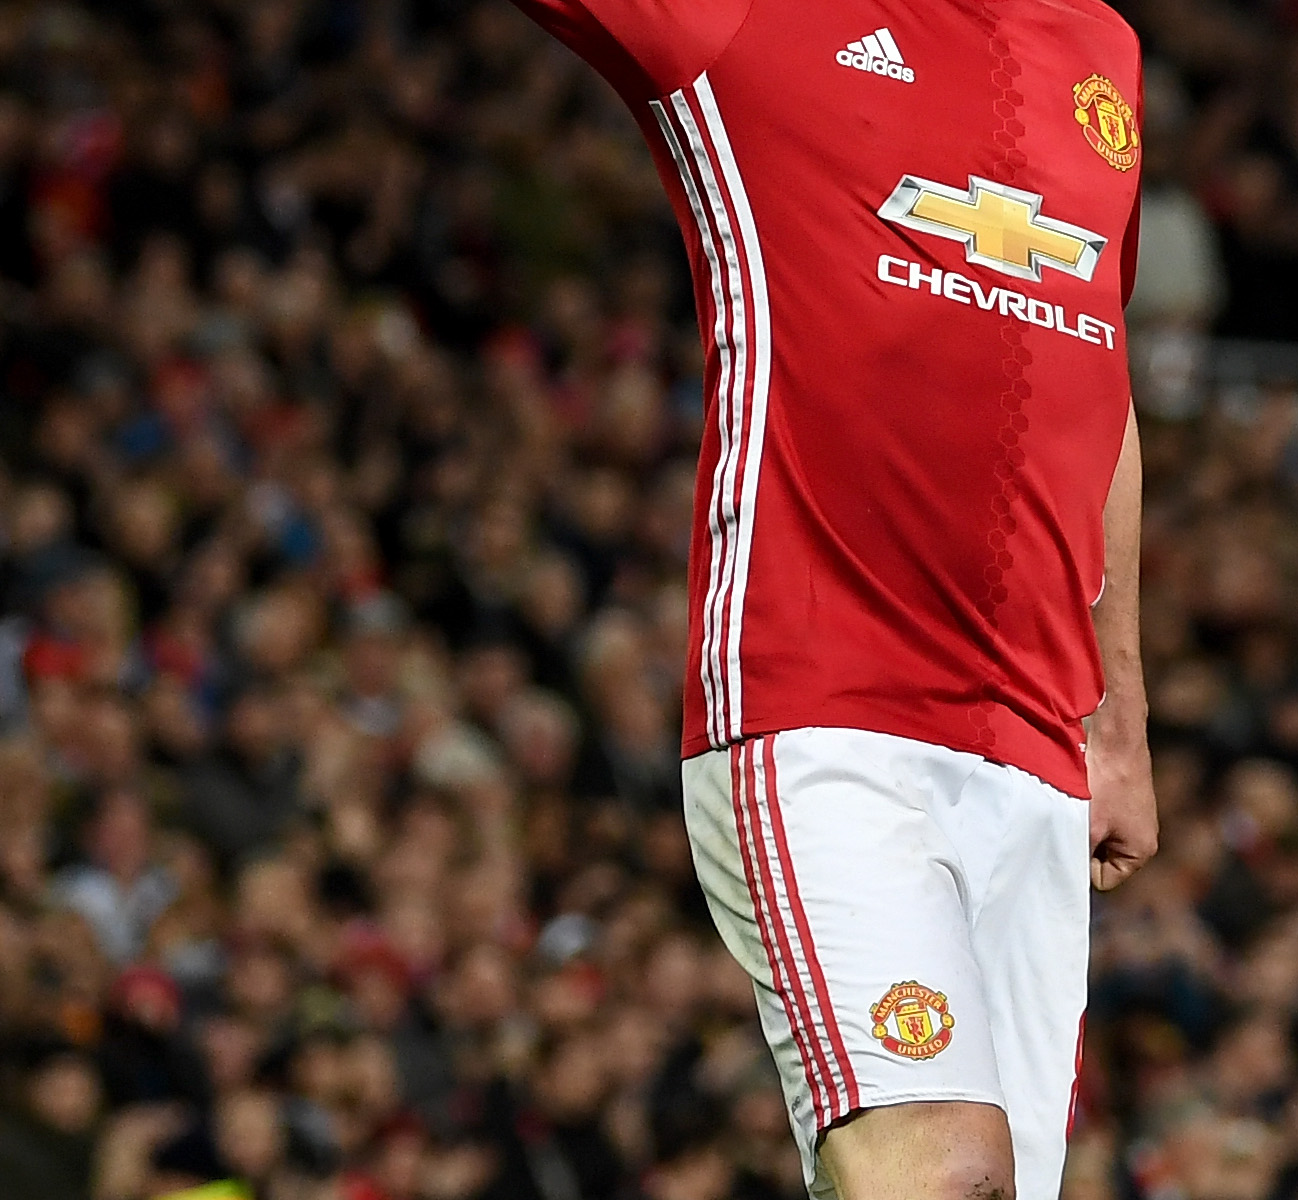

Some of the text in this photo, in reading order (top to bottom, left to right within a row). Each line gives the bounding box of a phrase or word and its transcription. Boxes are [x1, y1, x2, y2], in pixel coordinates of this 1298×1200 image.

[835, 49, 916, 84] adidas
[1096, 140, 1133, 165] UNITED
[876, 254, 1116, 351] CHEVROLET
[876, 987, 943, 1018] MANCHESTER
[897, 1039, 943, 1055] UNITED
